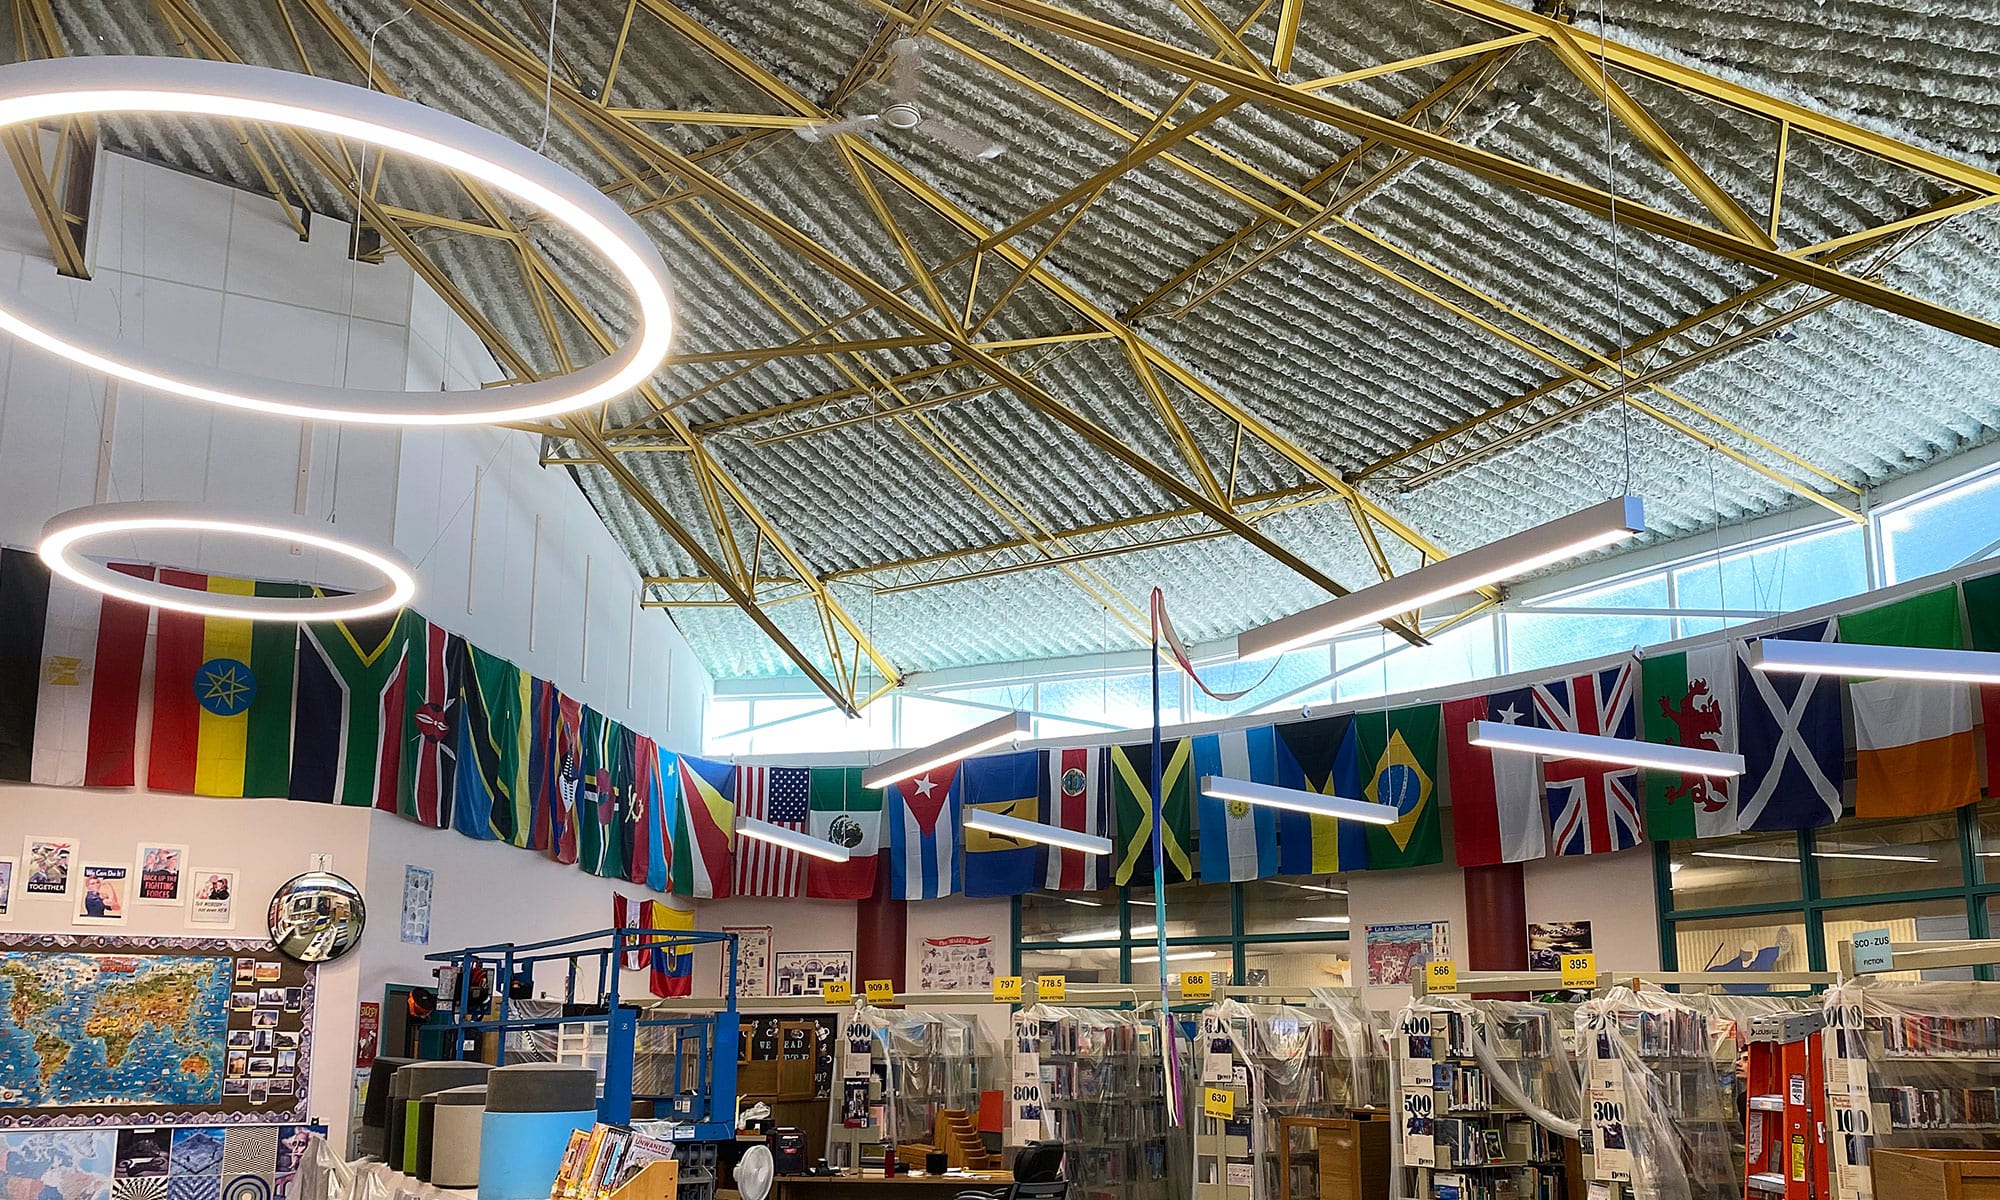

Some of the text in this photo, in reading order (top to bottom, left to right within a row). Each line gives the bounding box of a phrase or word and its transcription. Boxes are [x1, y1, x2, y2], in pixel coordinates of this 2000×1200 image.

[29, 883, 65, 891] TOGETHER
[145, 881, 174, 891] FIGHTING
[146, 890, 170, 898] FORCES
[1854, 939, 1869, 948] SCO
[1874, 936, 1889, 946] ZUS
[1569, 959, 1588, 970] 395
[1434, 966, 1449, 975] 566
[1000, 980, 1015, 988] 797
[1041, 979, 1062, 988] 778.5
[1187, 975, 1204, 984] 686
[868, 983, 890, 991] 909.8
[847, 1023, 870, 1037] 900
[1015, 1022, 1038, 1037] 700
[1400, 1017, 1430, 1034] 400
[759, 1041, 771, 1049] WE
[784, 1040, 803, 1049] EAD
[1014, 1086, 1039, 1101] 800
[1211, 1093, 1227, 1103] 630
[1404, 1094, 1432, 1112] 500
[1593, 1101, 1625, 1122] 300
[1835, 1109, 1869, 1133] 100
[635, 1138, 670, 1153] UNWANTED
